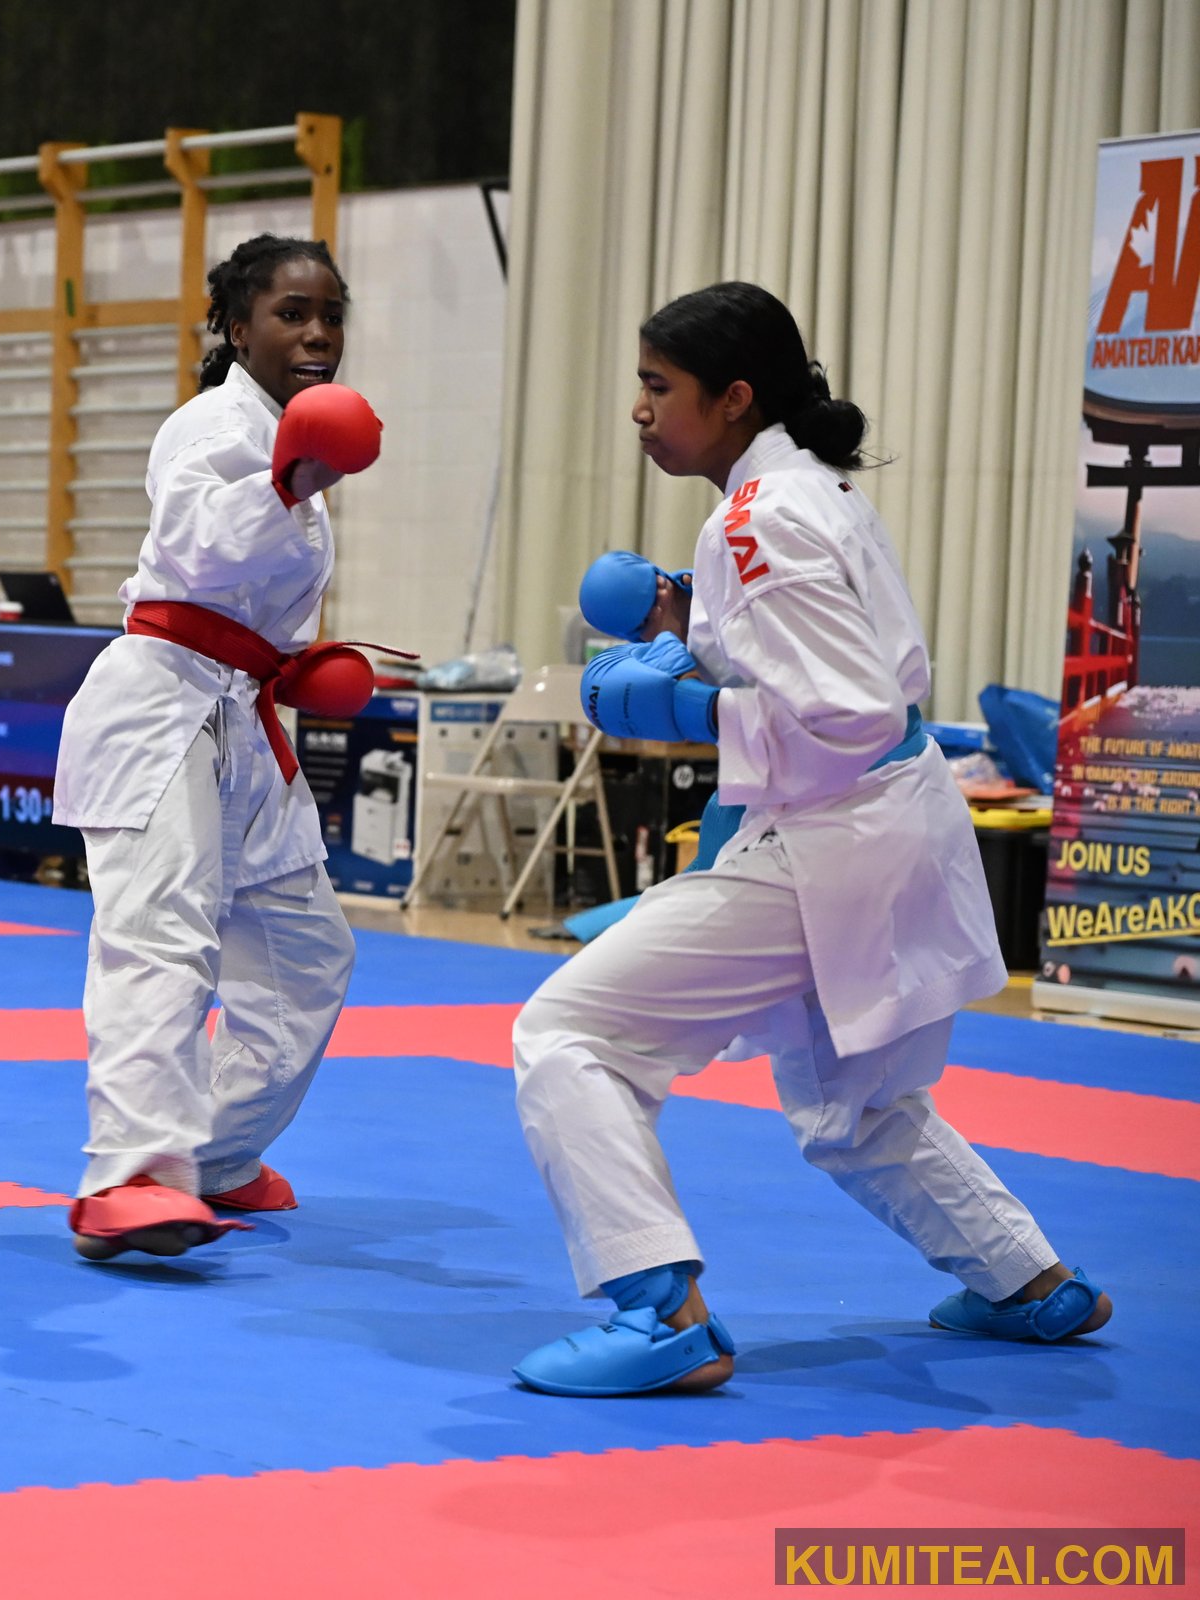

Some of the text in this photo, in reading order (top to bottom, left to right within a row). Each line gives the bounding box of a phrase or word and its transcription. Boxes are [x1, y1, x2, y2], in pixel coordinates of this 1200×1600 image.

[1092, 337, 1170, 369] AMATEUR
[724, 478, 770, 585] SMAI
[1080, 736, 1101, 754] THE
[1104, 738, 1146, 756] FUTURE
[1135, 797, 1156, 814] THE
[1160, 799, 1191, 816] RIGHT
[1056, 839, 1151, 878] JOIN US
